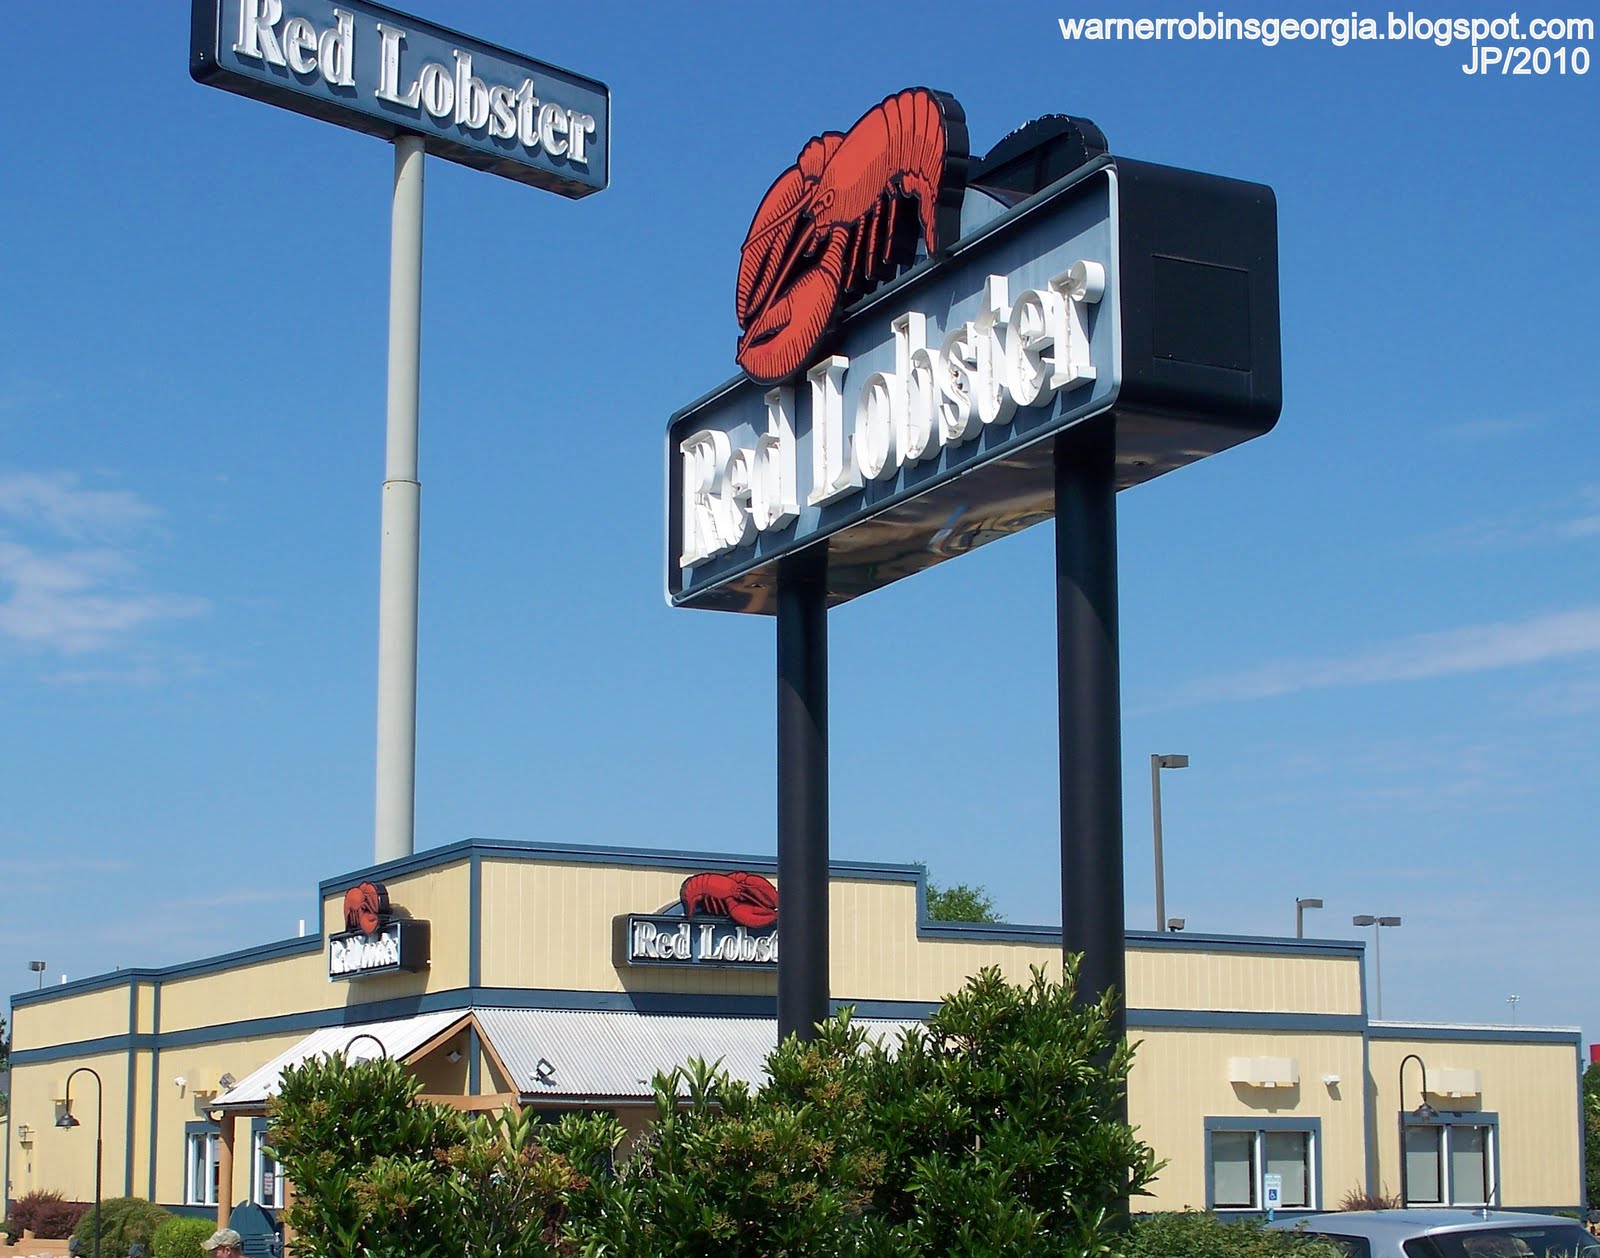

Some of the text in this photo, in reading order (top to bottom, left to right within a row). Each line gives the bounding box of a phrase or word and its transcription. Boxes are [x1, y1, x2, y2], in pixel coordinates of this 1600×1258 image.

[233, 0, 595, 164] Red Lobster
[680, 260, 1105, 568] Red Lobster
[633, 922, 778, 962] Red Lobst
